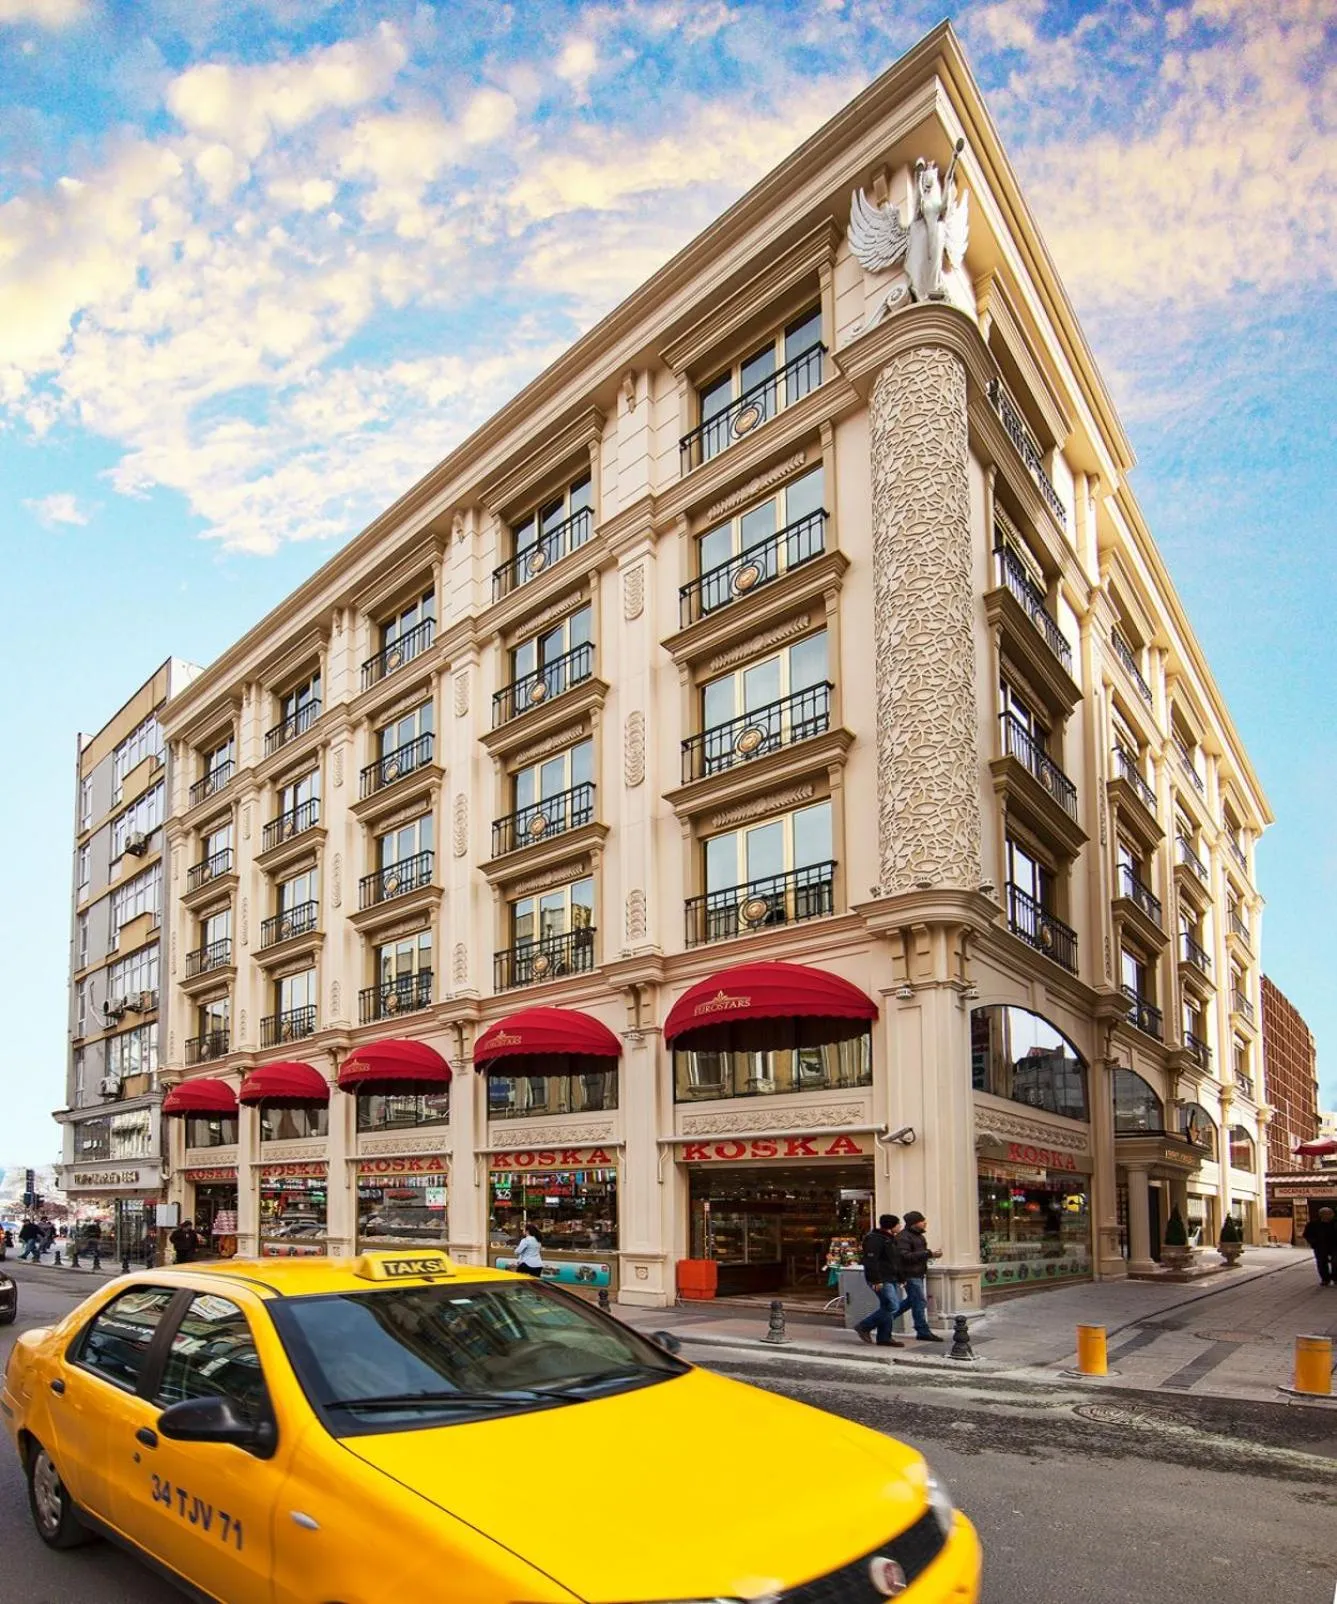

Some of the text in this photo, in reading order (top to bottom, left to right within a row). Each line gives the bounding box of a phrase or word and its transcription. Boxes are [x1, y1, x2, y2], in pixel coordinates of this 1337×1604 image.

[693, 999, 751, 1017] EUROSTARS
[682, 1133, 863, 1161] KOSKA
[1008, 1142, 1077, 1171] KOSKA
[360, 1155, 444, 1173] KOSKA
[492, 1148, 611, 1168] KOSKA
[185, 1167, 236, 1180] KOSKA
[262, 1161, 326, 1177] KOSKA
[151, 1473, 243, 1552] 34 TJV 71
